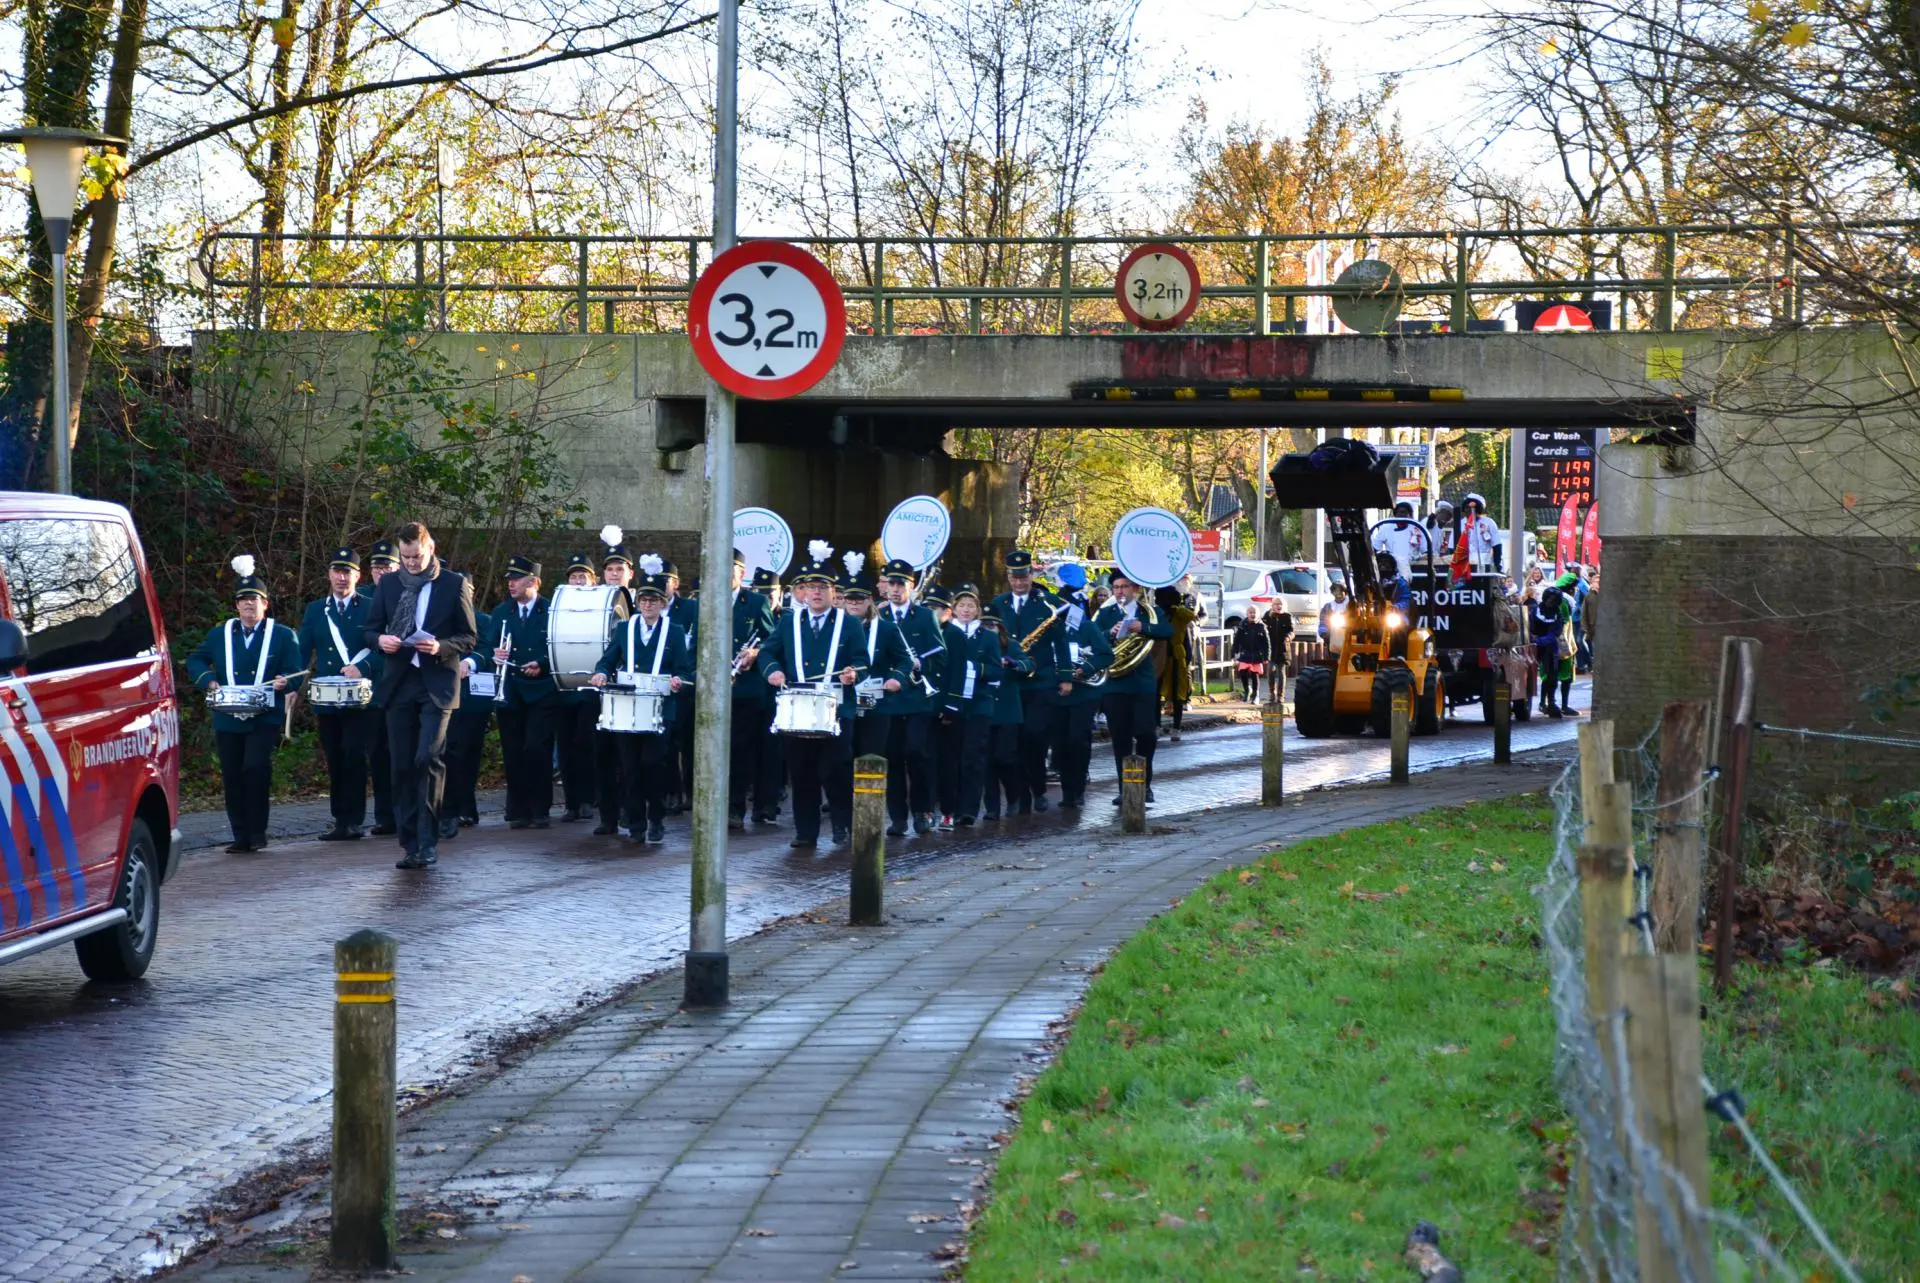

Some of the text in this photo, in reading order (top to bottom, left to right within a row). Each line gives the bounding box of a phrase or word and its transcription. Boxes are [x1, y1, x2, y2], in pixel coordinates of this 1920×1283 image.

[1133, 279, 1183, 302] 3,2m
[715, 293, 818, 351] 3,2m
[1532, 432, 1580, 440] Car Wash
[1534, 446, 1569, 456] Cards
[1553, 461, 1590, 475] 1.199
[1553, 477, 1590, 490] 1.499
[896, 512, 940, 525] AMICITIA
[1126, 526, 1179, 540] AMICITIA
[83, 735, 138, 768] BRANDWEER
